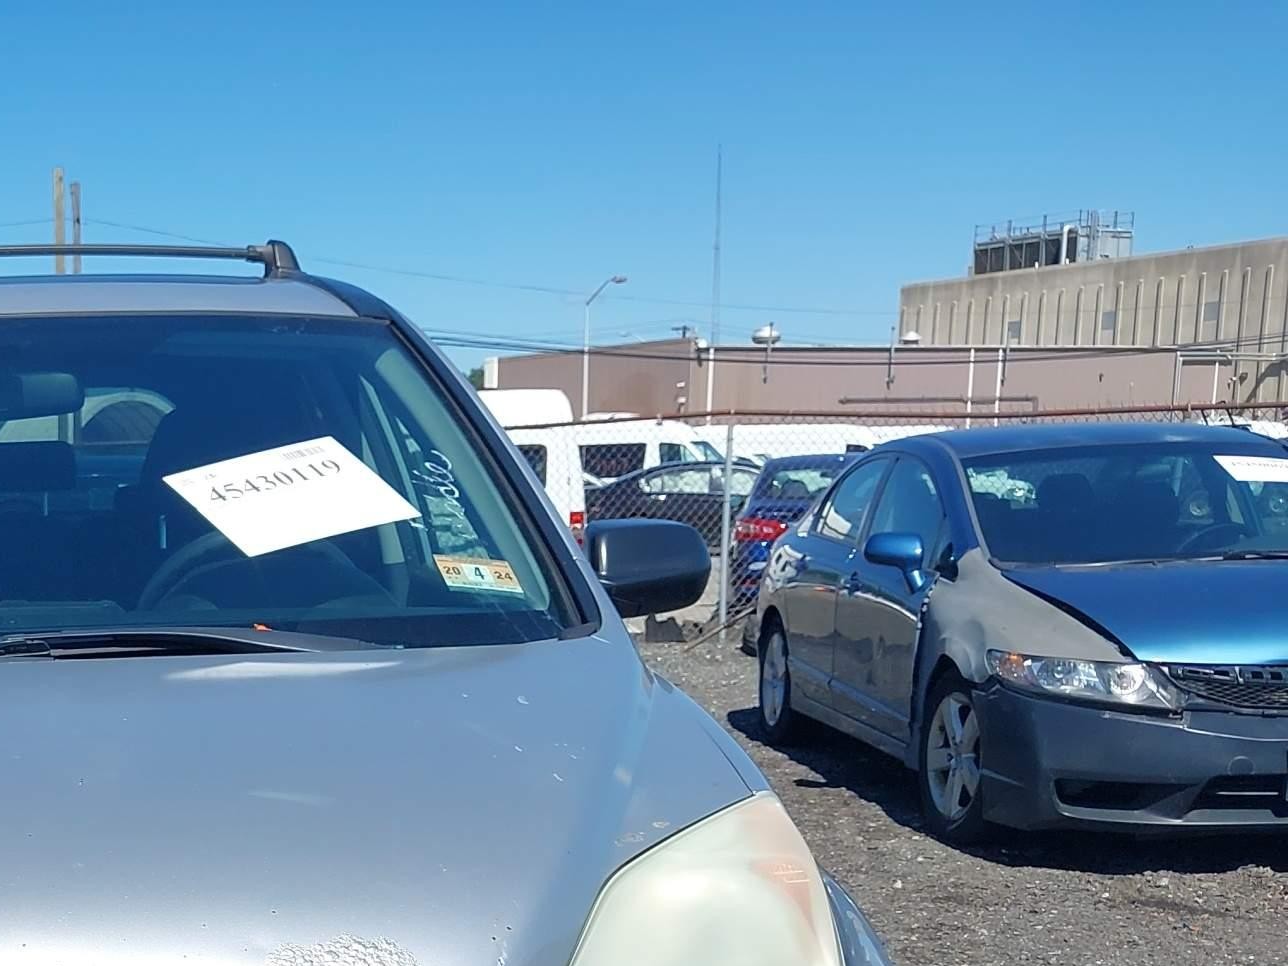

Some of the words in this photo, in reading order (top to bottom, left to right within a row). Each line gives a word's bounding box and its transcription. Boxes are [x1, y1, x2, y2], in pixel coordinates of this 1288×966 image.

[210, 459, 341, 502] 45430119
[442, 565, 462, 576] 20
[474, 567, 485, 580] 4
[493, 570, 513, 582] 24
